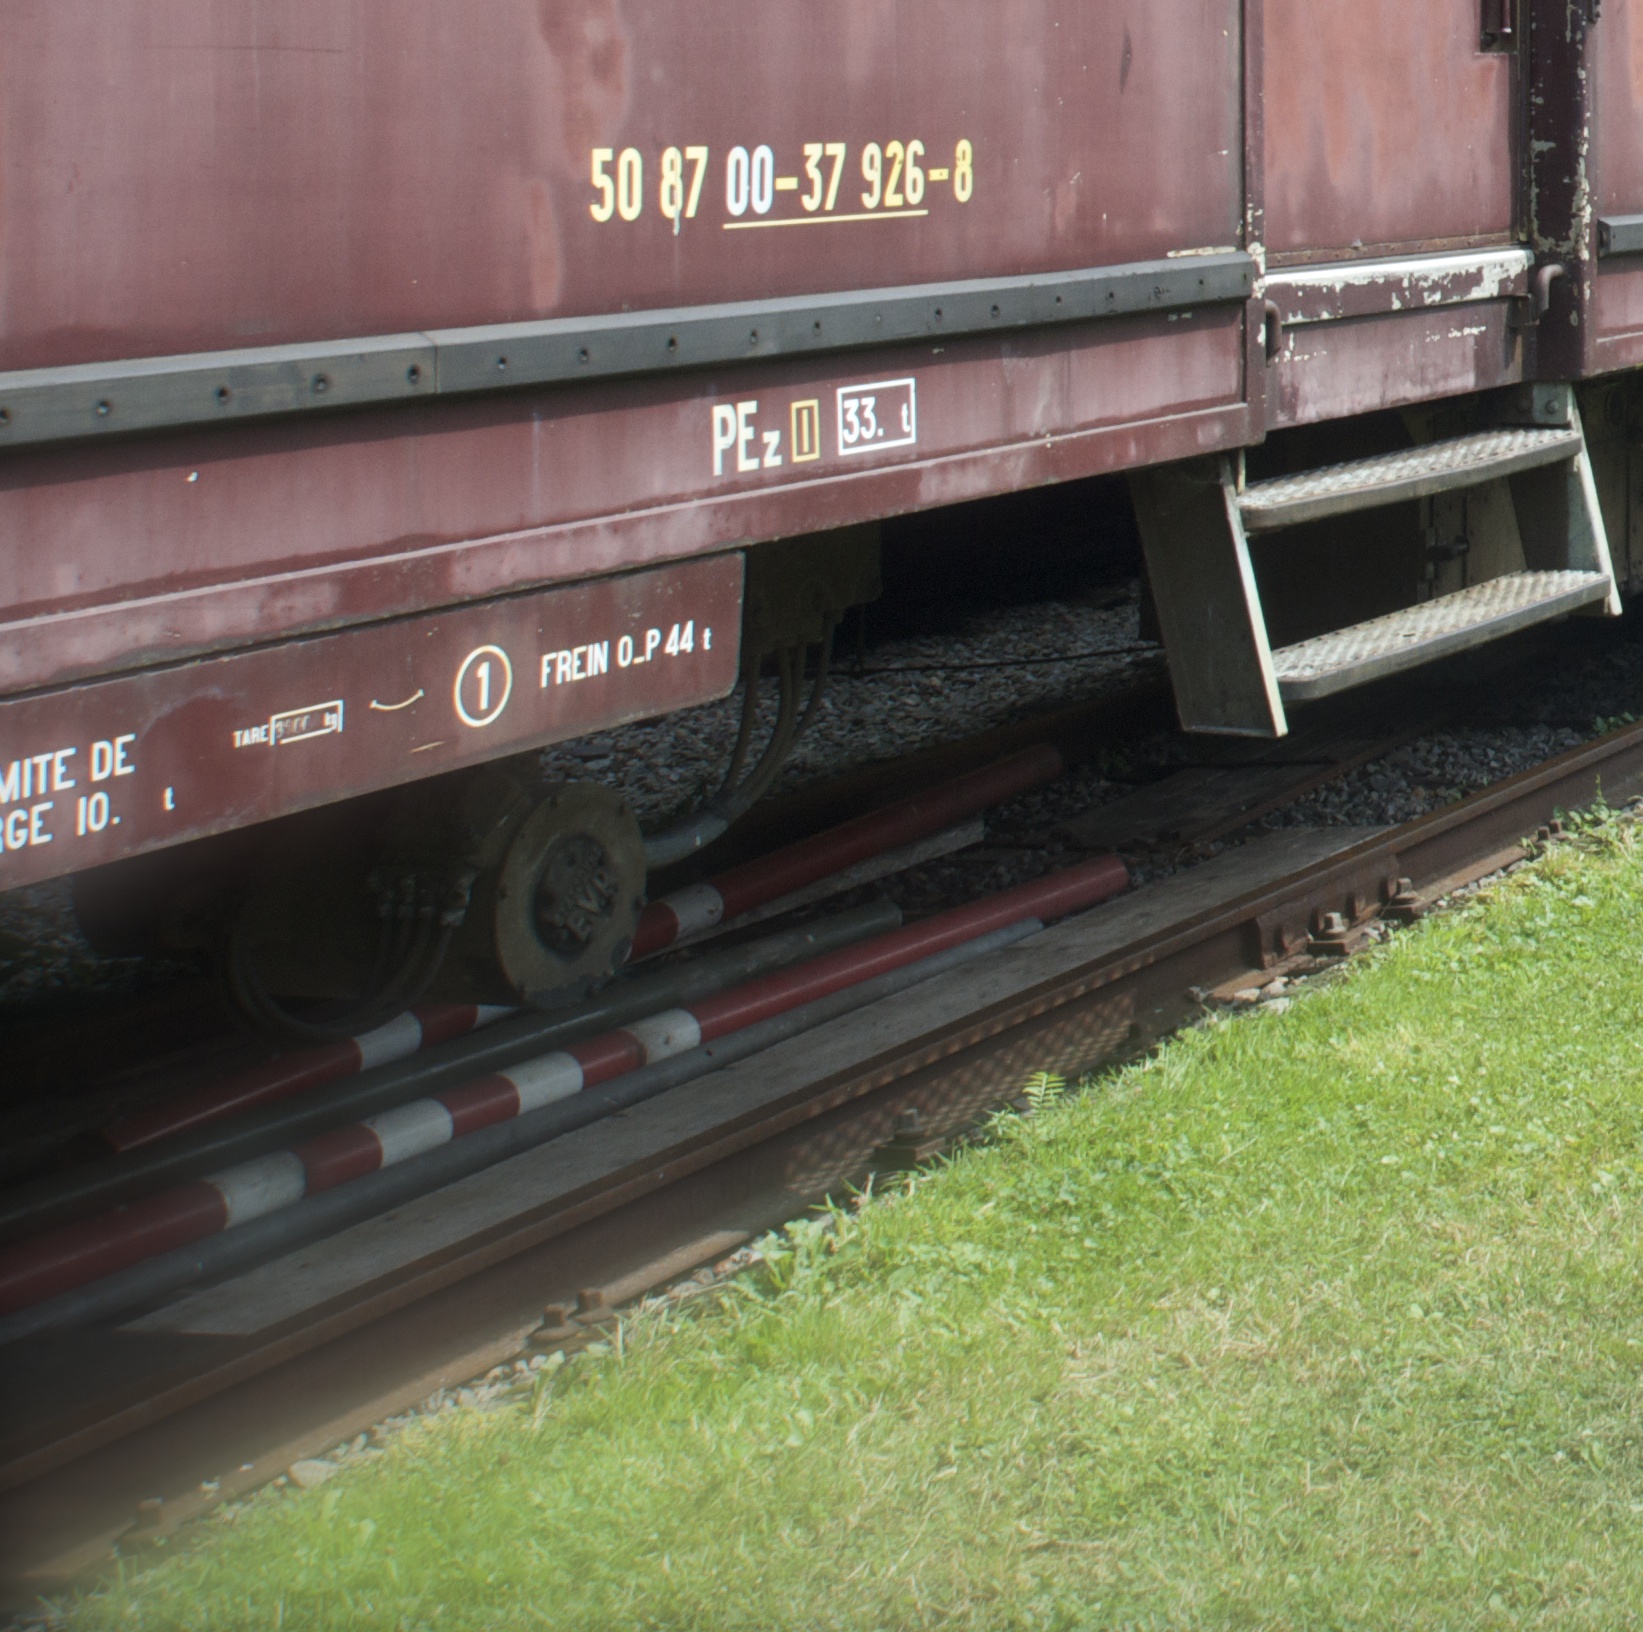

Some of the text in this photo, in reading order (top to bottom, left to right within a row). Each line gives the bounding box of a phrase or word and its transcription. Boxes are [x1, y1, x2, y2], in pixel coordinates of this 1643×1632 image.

[590, 147, 643, 221] 50
[660, 146, 708, 219] 87
[540, 640, 609, 688] FREIN
[664, 620, 694, 656] 44
[702, 628, 712, 650] t
[90, 732, 136, 782] DE
[233, 724, 269, 748] TARE
[0, 801, 53, 854] GE
[164, 786, 175, 811] t
